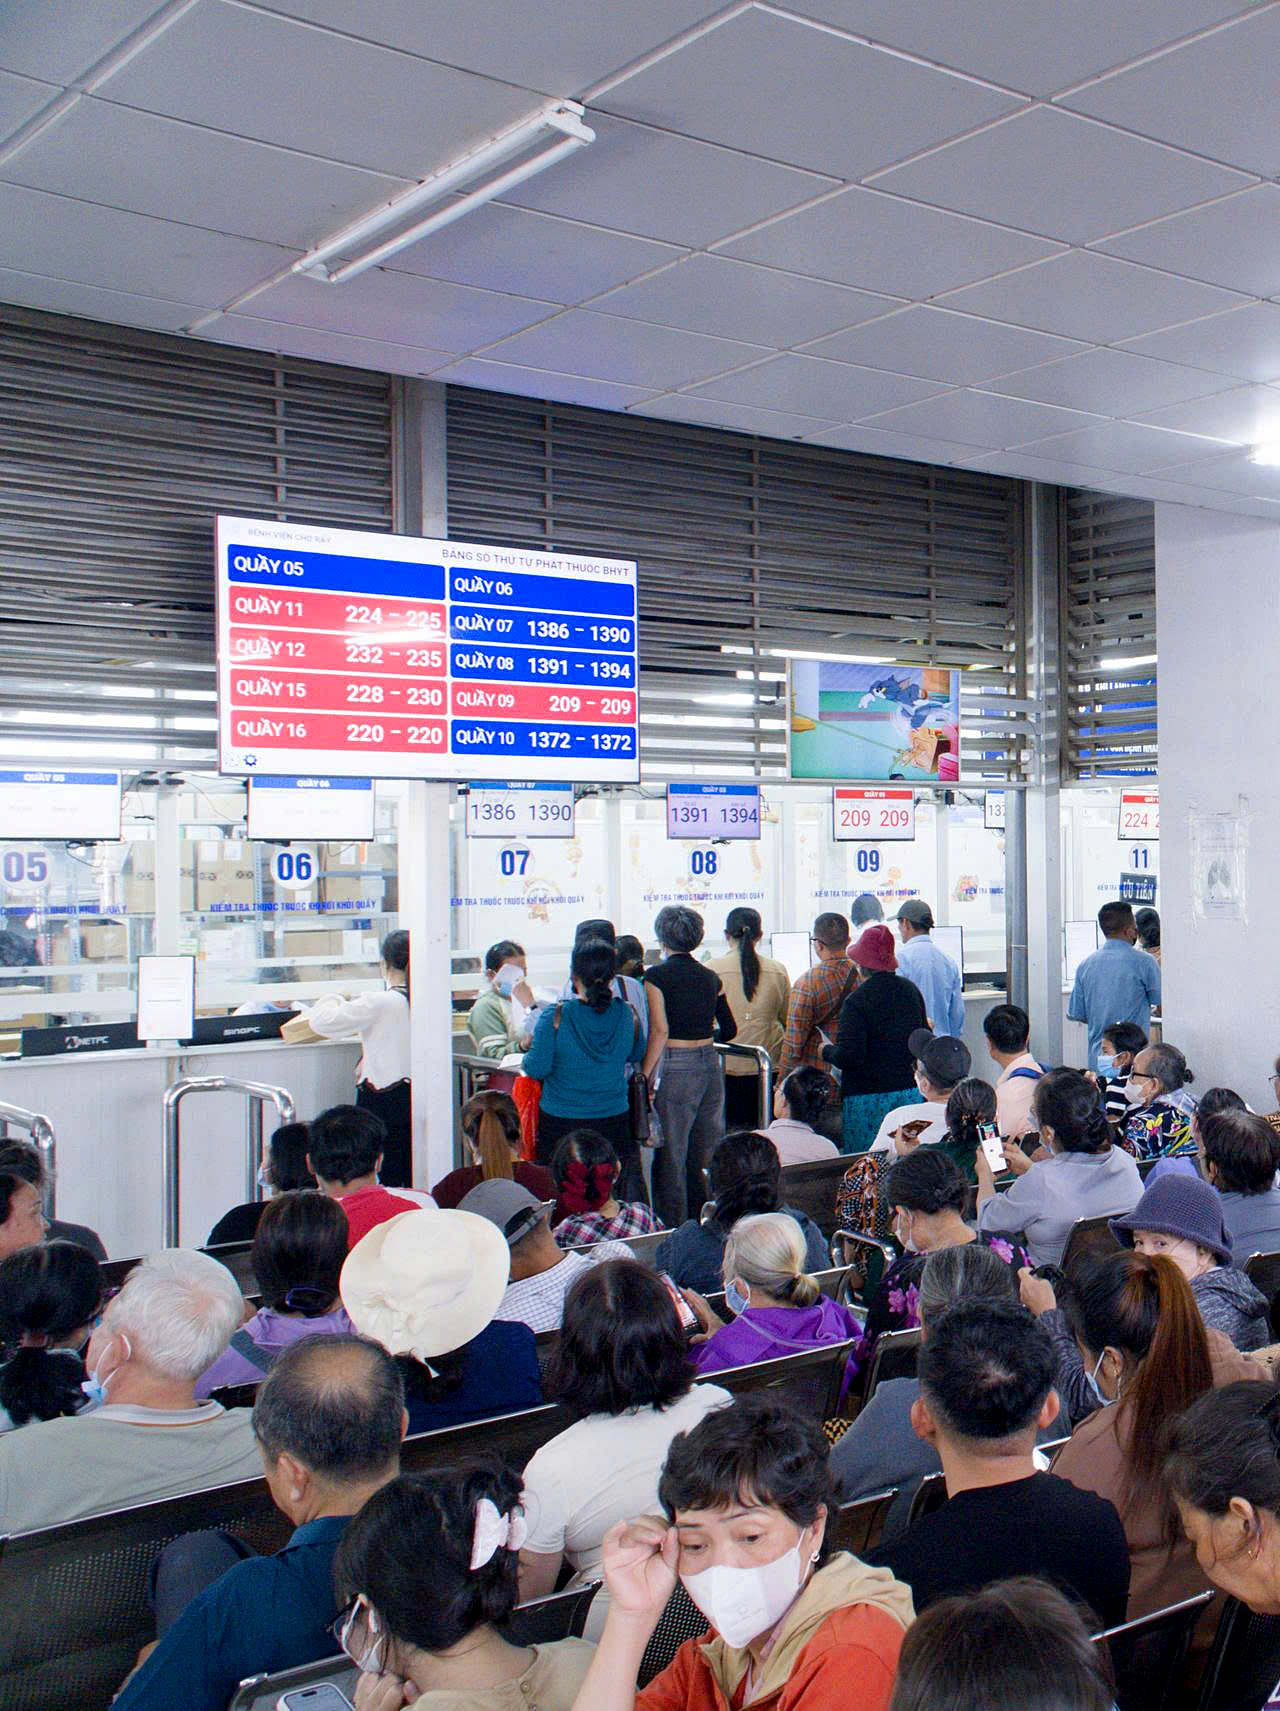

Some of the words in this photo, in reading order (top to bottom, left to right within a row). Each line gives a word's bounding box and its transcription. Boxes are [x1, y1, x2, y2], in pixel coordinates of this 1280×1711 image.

[283, 559, 304, 576] 05
[603, 566, 629, 577] BHYT
[495, 581, 513, 595] 06
[285, 602, 303, 616] 11
[344, 605, 384, 624] 224
[406, 610, 442, 630] 225
[496, 619, 514, 633] 07
[527, 620, 570, 639] 1386
[590, 625, 630, 644] 1390
[285, 642, 306, 657] 12
[345, 645, 383, 664] 232
[406, 649, 442, 667] 235
[496, 656, 514, 670] 08
[528, 657, 568, 676] 1391
[591, 662, 631, 679] 1394
[286, 682, 306, 698] 15
[346, 684, 384, 703] 228
[407, 687, 442, 706] 230
[497, 694, 515, 707] 09
[549, 695, 581, 712] 209
[601, 698, 631, 715] 209
[286, 723, 307, 738] 16
[347, 724, 384, 742] 220
[408, 727, 442, 744] 220
[498, 731, 515, 746] 10
[528, 732, 571, 749] 1372
[591, 734, 632, 751] 1372
[471, 804, 516, 820] 1386
[529, 805, 572, 821] 1390
[671, 807, 708, 822] 1391
[720, 808, 758, 823] 1394
[841, 809, 871, 827] 209
[880, 810, 909, 827] 209
[1125, 813, 1148, 828] 224
[3, 851, 48, 882] 05
[277, 853, 312, 880] 06
[501, 850, 530, 876] 07
[691, 850, 717, 874] 08
[857, 850, 880, 873] 09
[1132, 848, 1148, 868] 11
